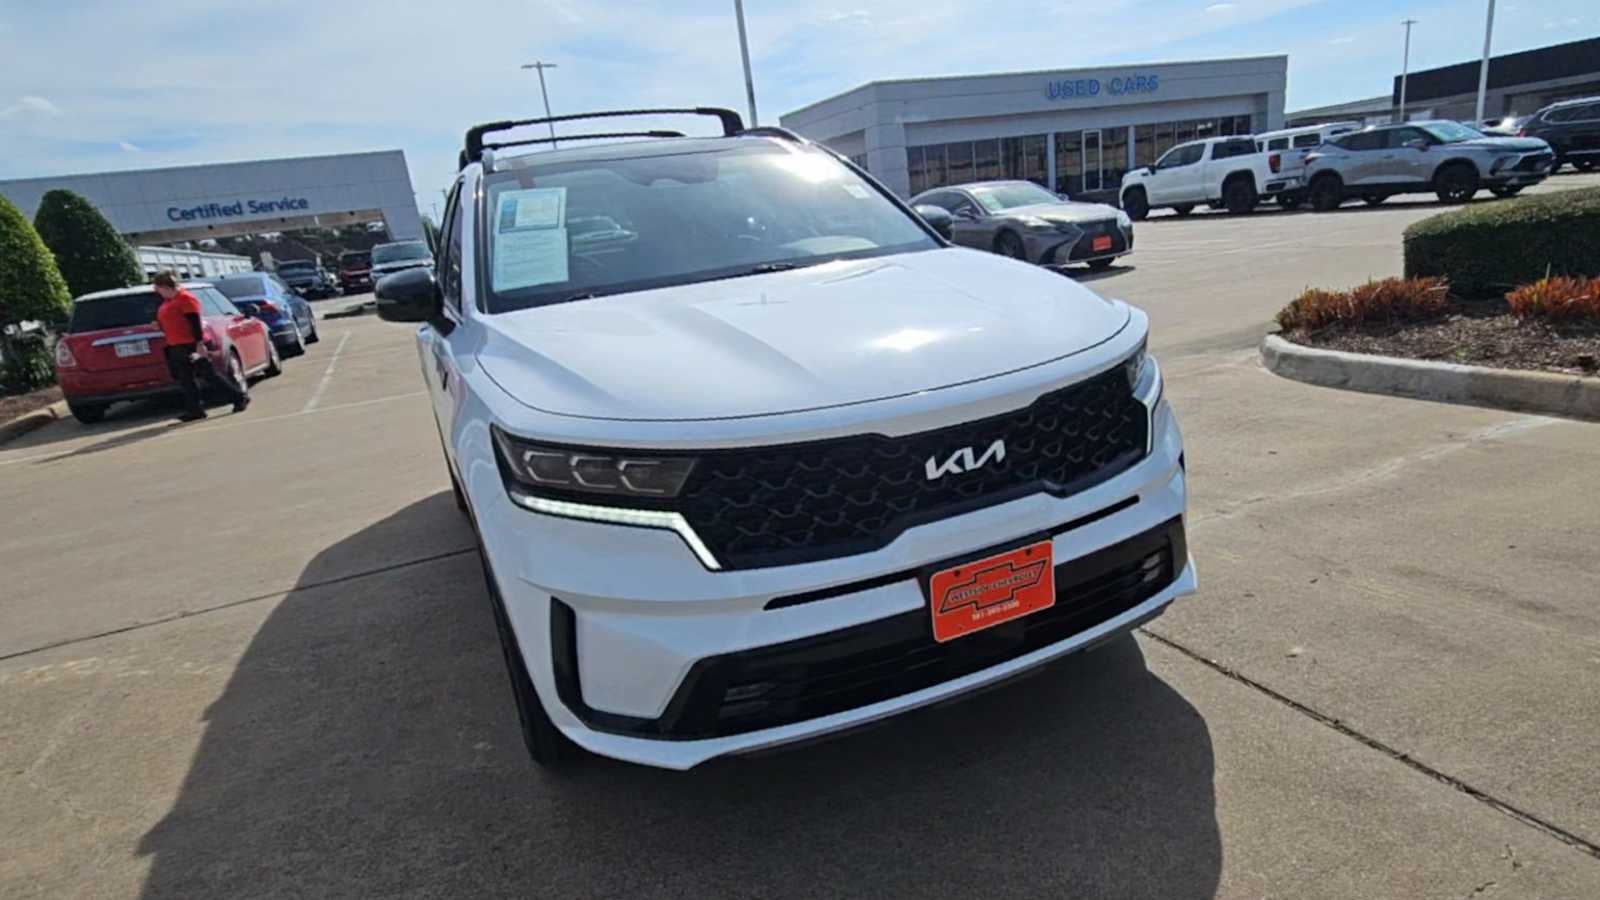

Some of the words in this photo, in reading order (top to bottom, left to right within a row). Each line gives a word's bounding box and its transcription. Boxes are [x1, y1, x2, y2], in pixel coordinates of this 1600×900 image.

[1046, 79, 1100, 98] USED
[1108, 75, 1159, 96] CARS
[167, 201, 243, 221] Certified
[247, 197, 309, 214] Service
[925, 439, 1006, 480] KIA
